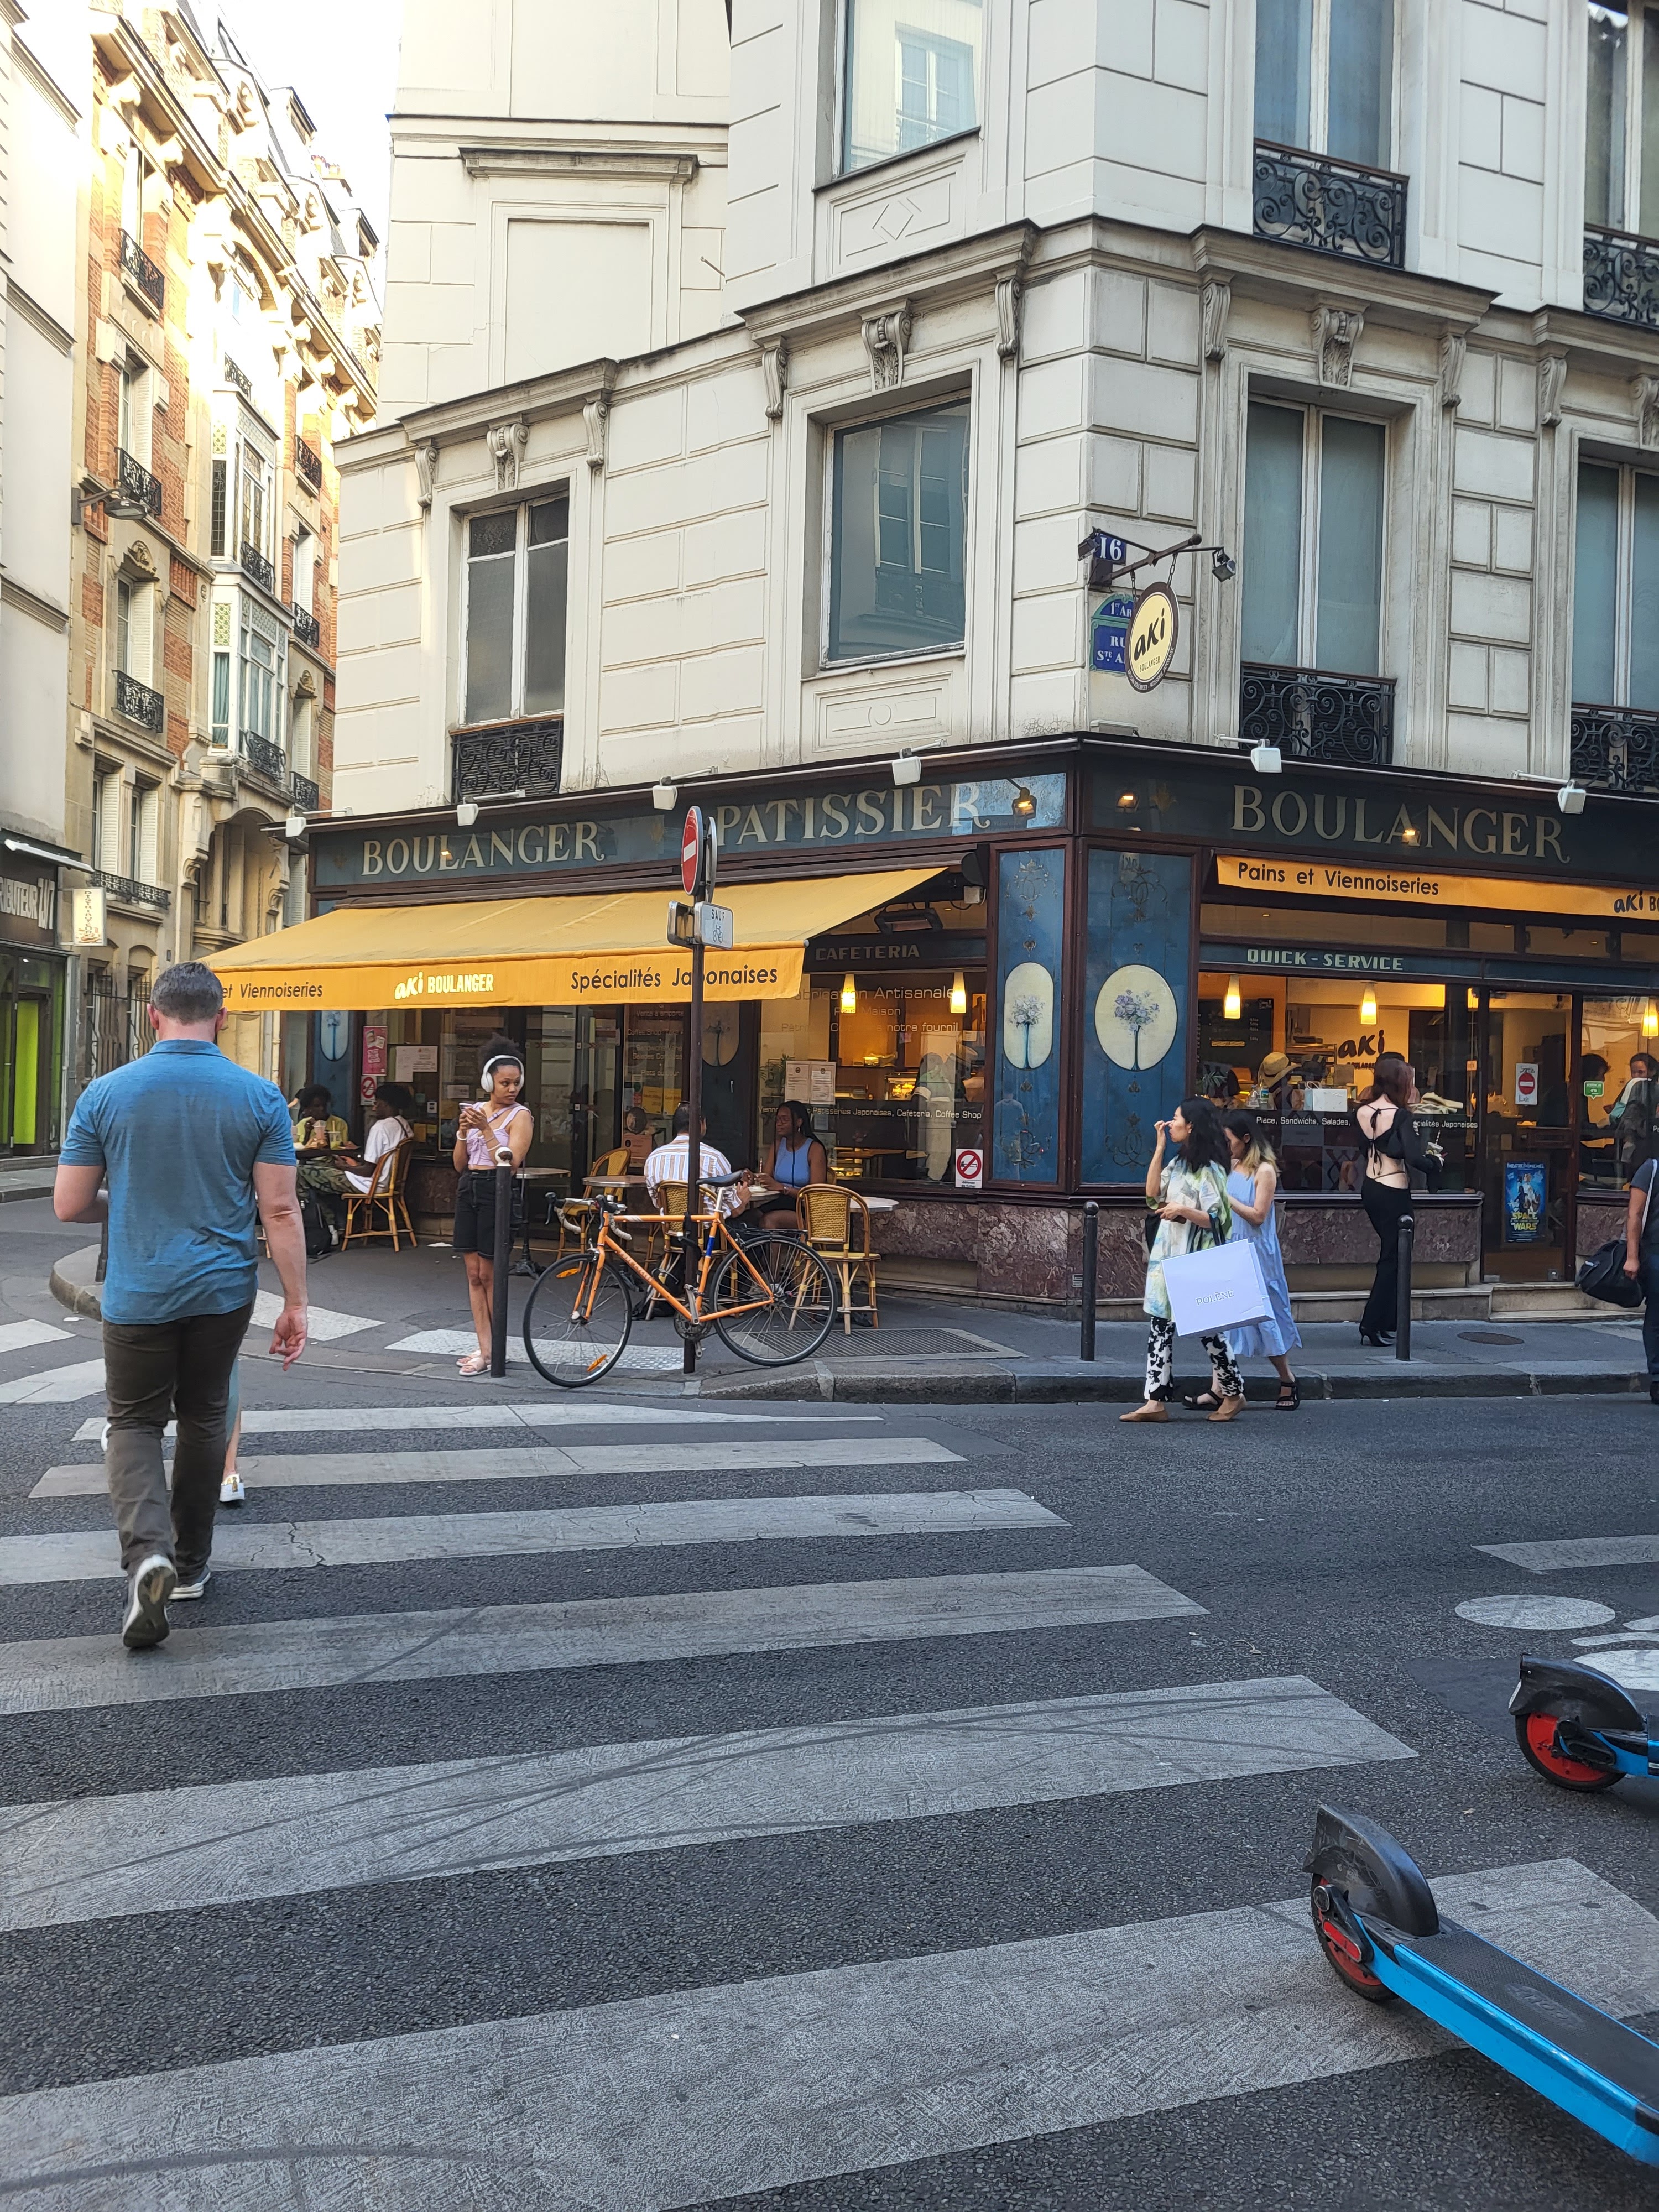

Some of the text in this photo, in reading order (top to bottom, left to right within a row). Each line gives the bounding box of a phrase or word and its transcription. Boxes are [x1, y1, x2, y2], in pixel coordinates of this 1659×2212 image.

[1099, 536, 1122, 561] 16
[1119, 606, 1132, 617] AR
[1110, 635, 1125, 648] RU
[1139, 656, 1160, 672] BOULANGER
[716, 784, 990, 846] PATISSIER
[1230, 785, 1571, 863] BOULANGER
[361, 821, 606, 876] BOULANGER
[1238, 862, 1439, 896] Pains et Viennoiseries
[711, 909, 725, 922] SAUF
[816, 944, 921, 961] CAFETERIA
[427, 974, 494, 994] BOULANGER
[571, 964, 778, 993] Spécialités Jaonaises
[222, 982, 323, 998] et Viennoiseries
[874, 985, 954, 1000] Artisanale
[862, 1006, 901, 1015] Maison
[887, 1024, 918, 1032] notre
[922, 1022, 958, 1032] fournil
[812, 1107, 851, 1115] Pâtisseries
[853, 1108, 894, 1117] Japonaises,
[935, 1110, 960, 1118] Coffee
[962, 1110, 982, 1119] Shop
[1256, 1116, 1278, 1125] Place,
[1280, 1117, 1319, 1126] Sandwichs,
[1322, 1118, 1351, 1126] Salades,
[1441, 1120, 1478, 1129] Japonaises
[1511, 1212, 1538, 1220] SPACE
[1511, 1222, 1538, 1230] WARS
